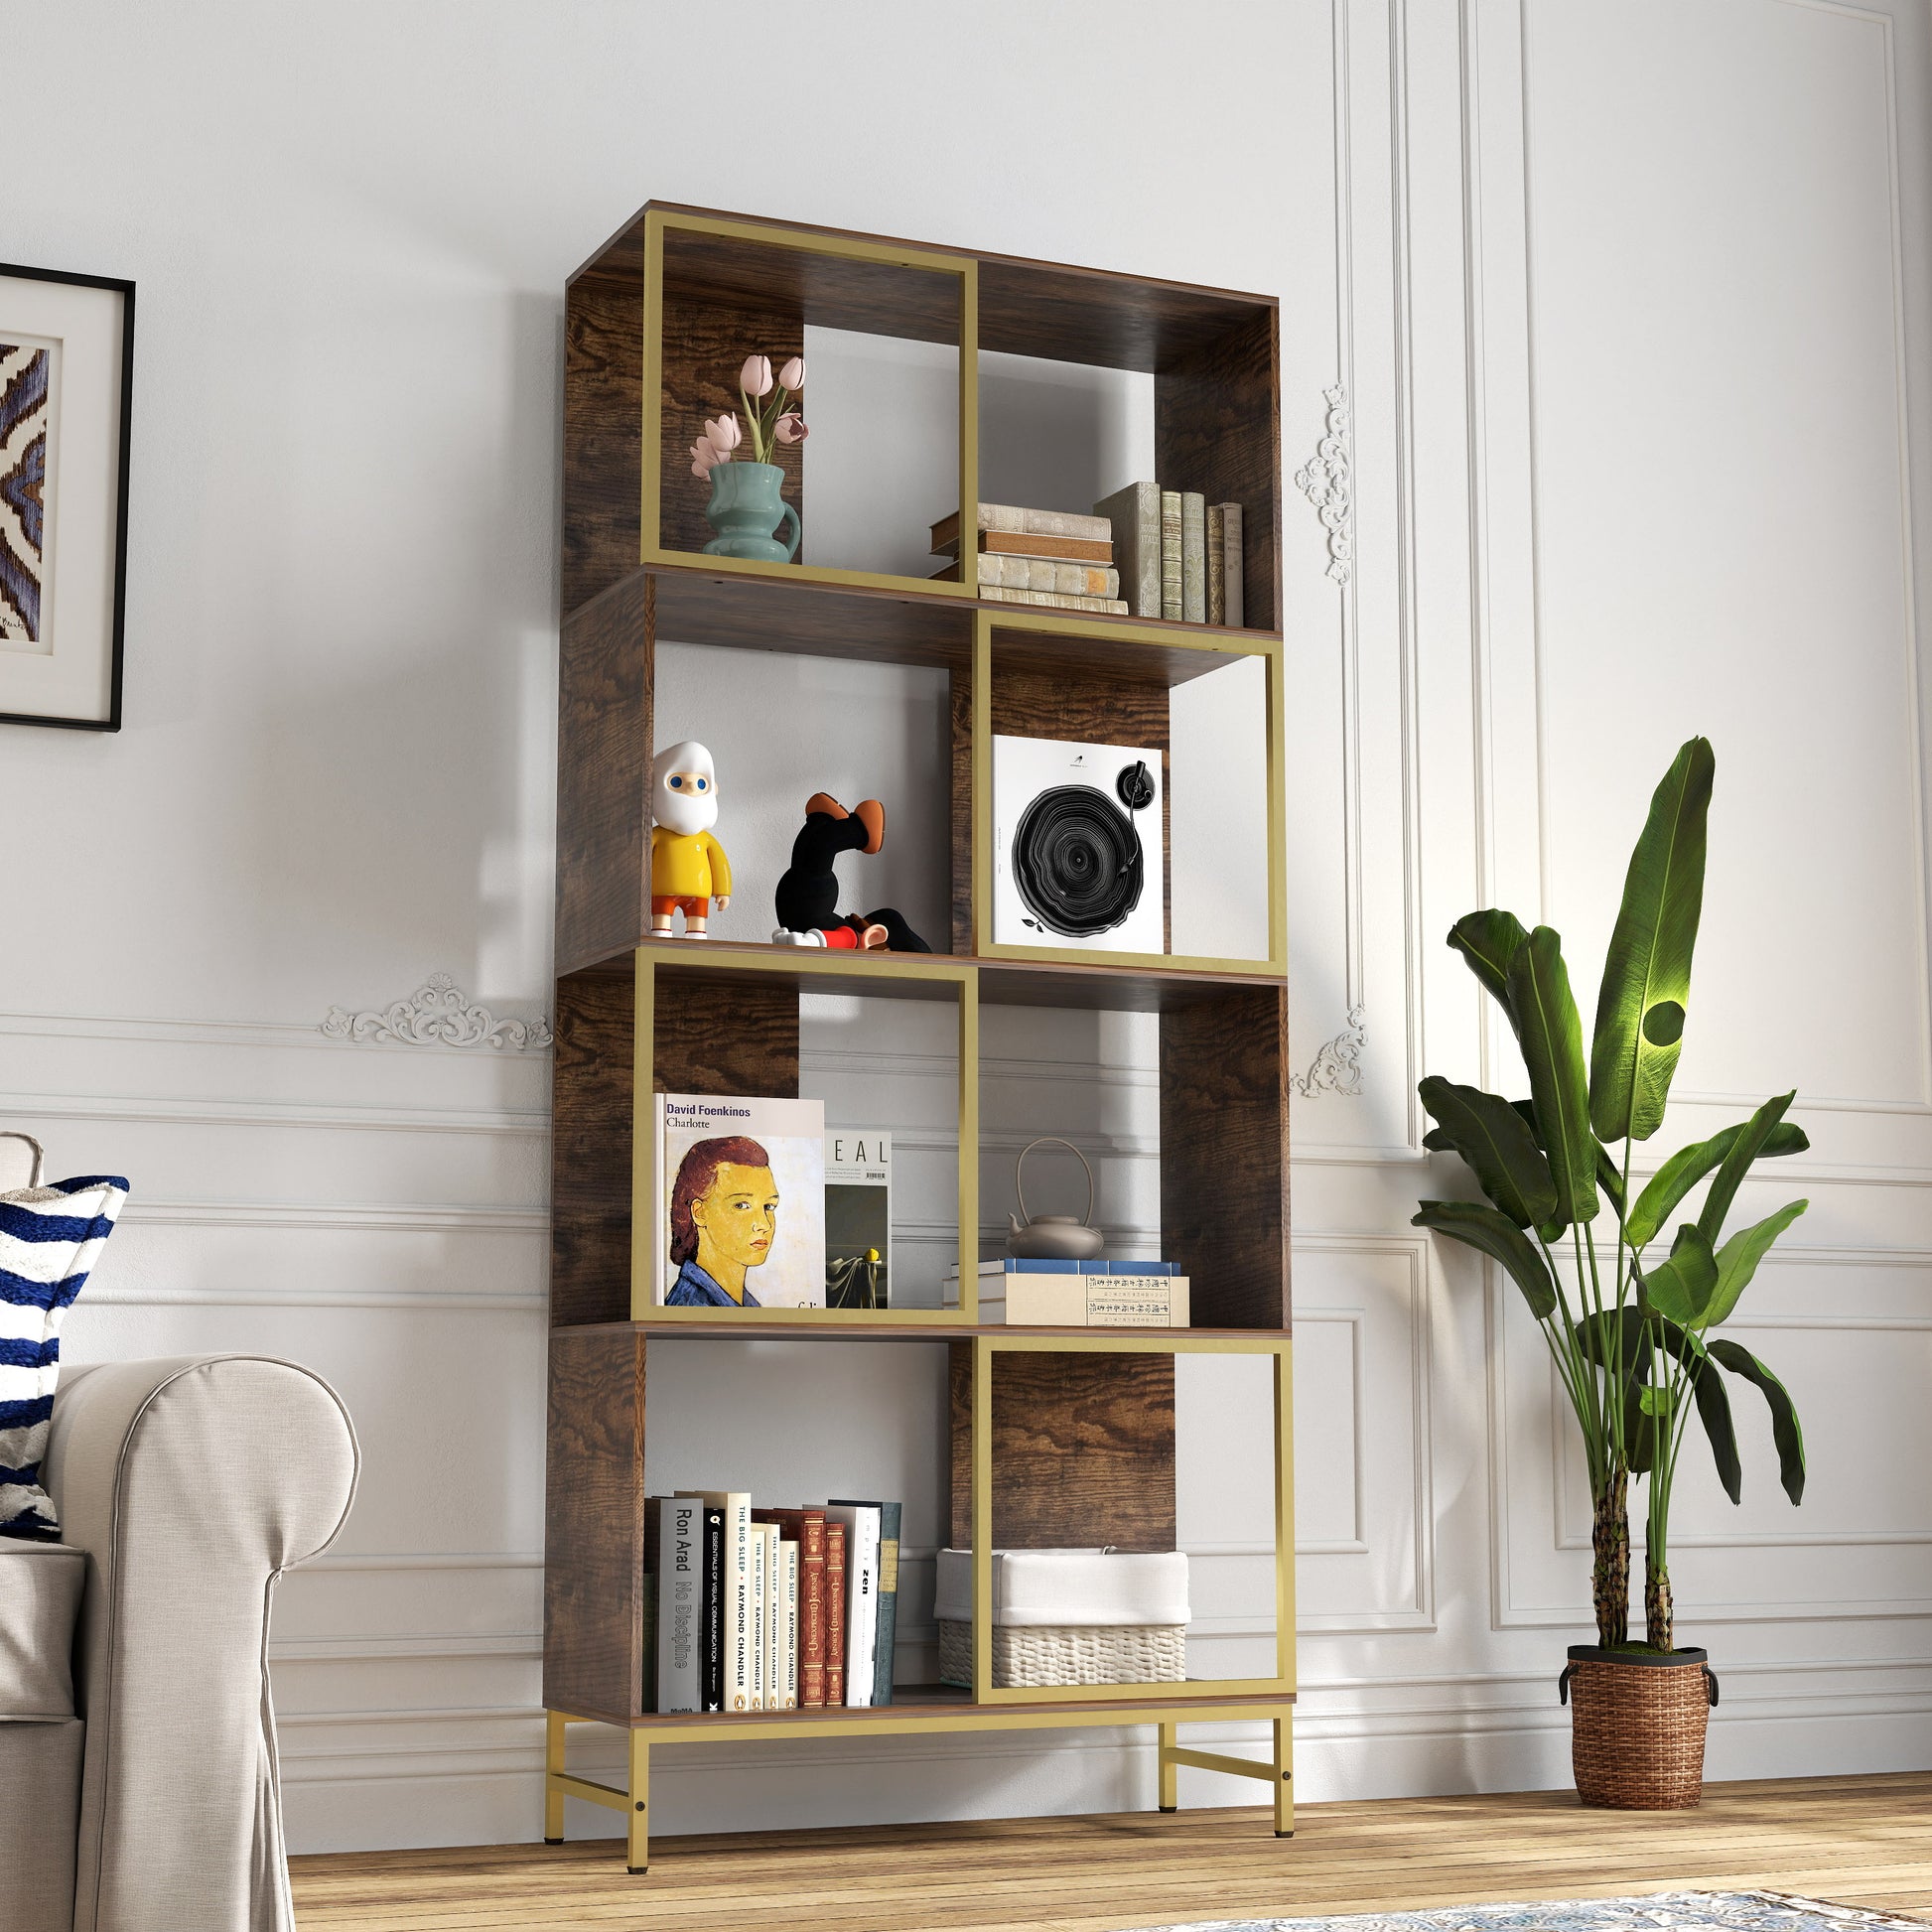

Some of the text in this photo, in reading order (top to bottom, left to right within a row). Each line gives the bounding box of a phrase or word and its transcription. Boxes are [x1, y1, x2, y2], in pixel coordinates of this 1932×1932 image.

[667, 1104, 751, 1118] David Foenkinos
[666, 1117, 710, 1129] Charlotte
[712, 1572, 718, 1581] OF
[671, 1508, 692, 1669] Ron Arad No Discipline
